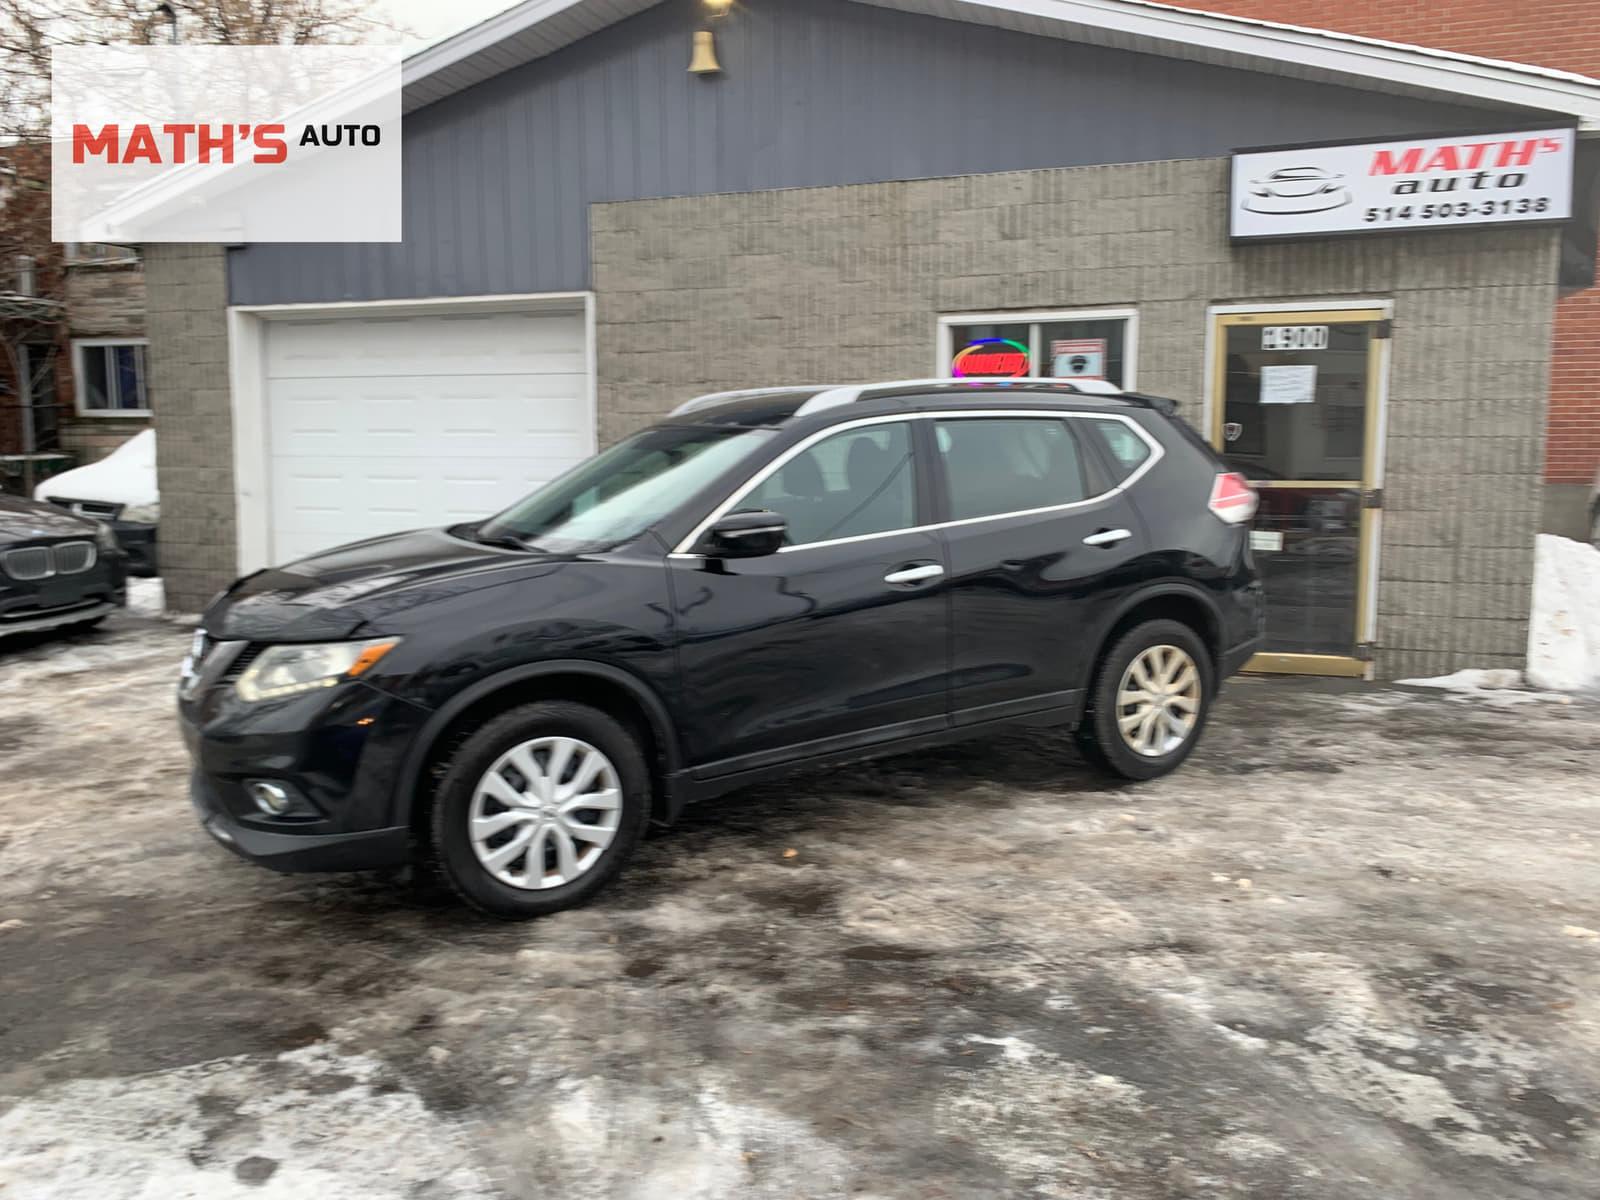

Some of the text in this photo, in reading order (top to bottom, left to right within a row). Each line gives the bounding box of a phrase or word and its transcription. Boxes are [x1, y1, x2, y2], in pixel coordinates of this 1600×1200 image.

[1392, 171, 1527, 195] auto
[1364, 197, 1550, 223] 514 503-3138
